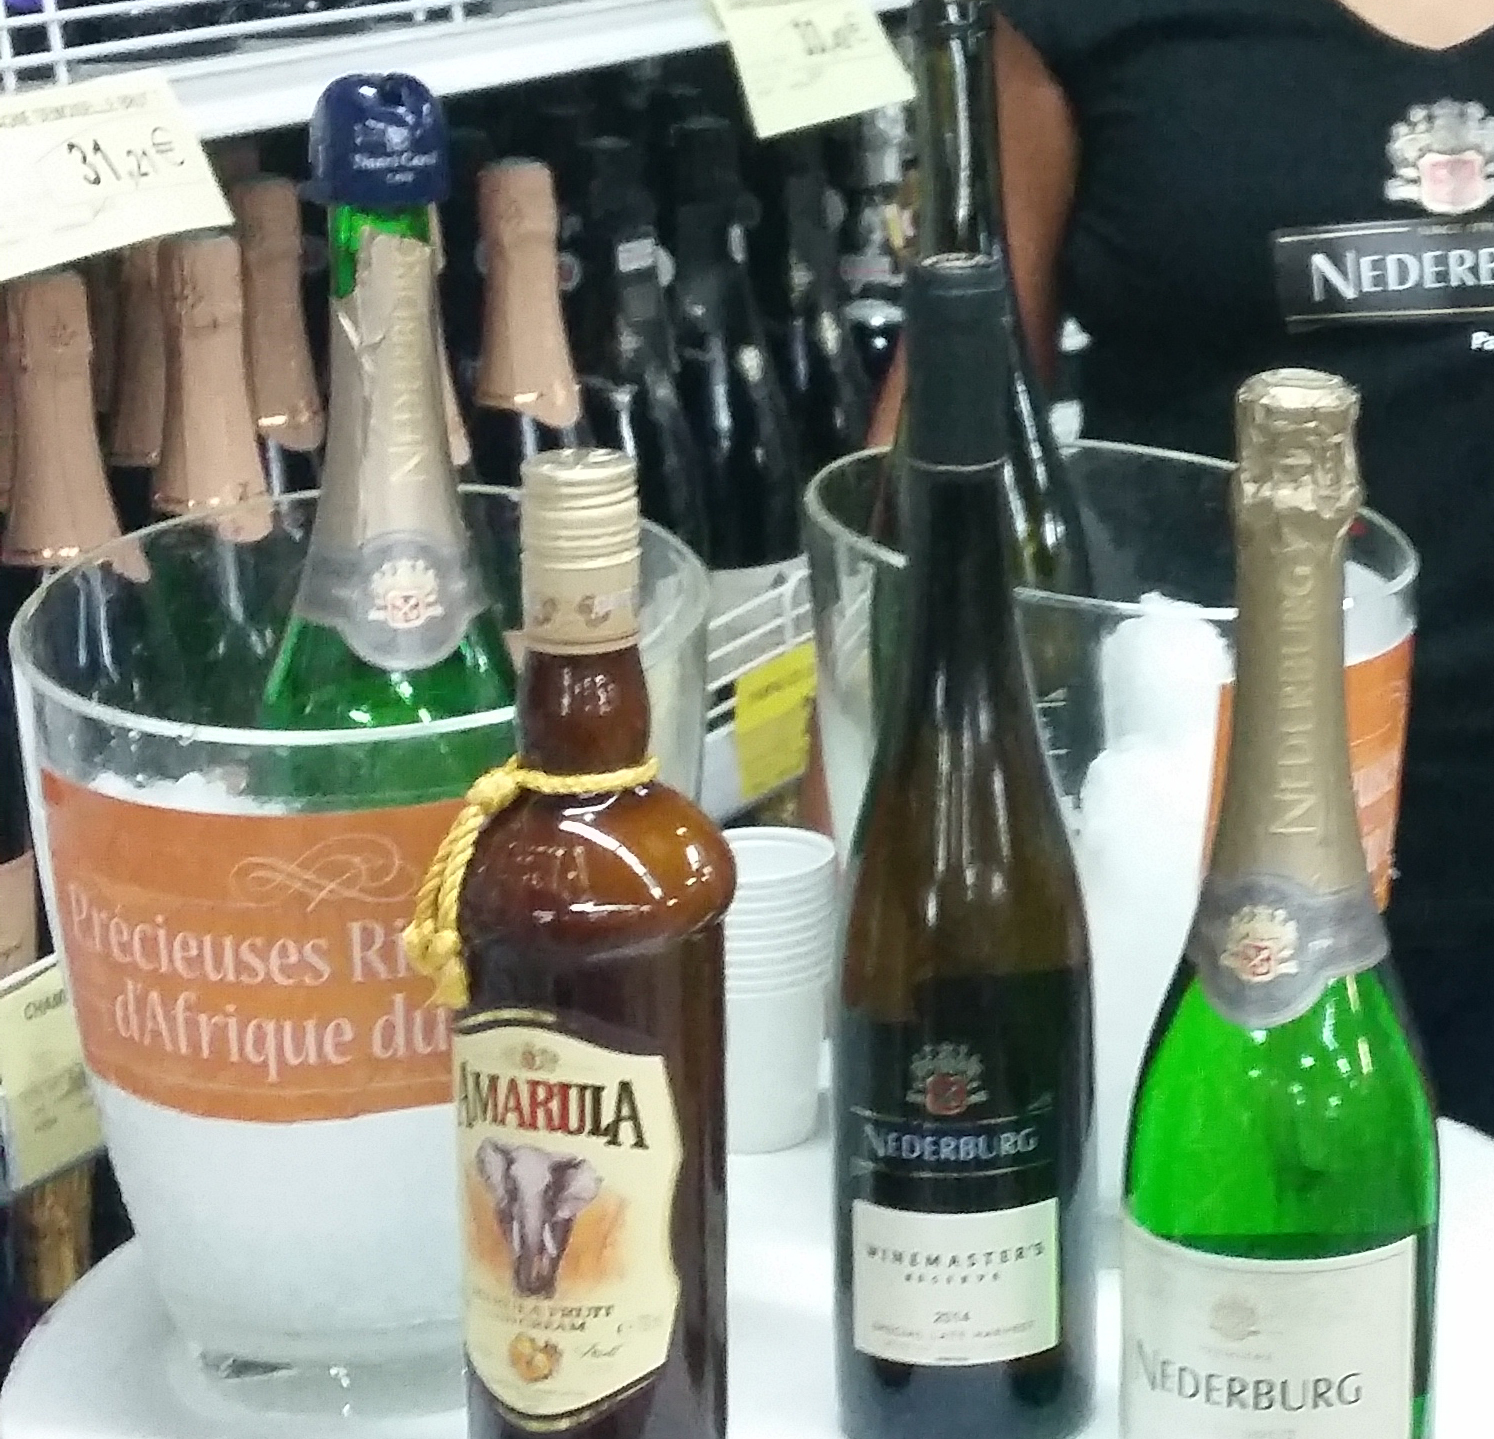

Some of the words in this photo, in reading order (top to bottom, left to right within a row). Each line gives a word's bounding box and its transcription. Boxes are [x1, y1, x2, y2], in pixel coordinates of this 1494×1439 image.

[69, 881, 332, 987] Précieuses
[114, 976, 354, 1082] d'Afrique
[457, 1060, 650, 1151] AMARULA
[863, 1122, 1040, 1162] NEDERBURG
[1135, 1337, 1364, 1412] NEDERBURG
